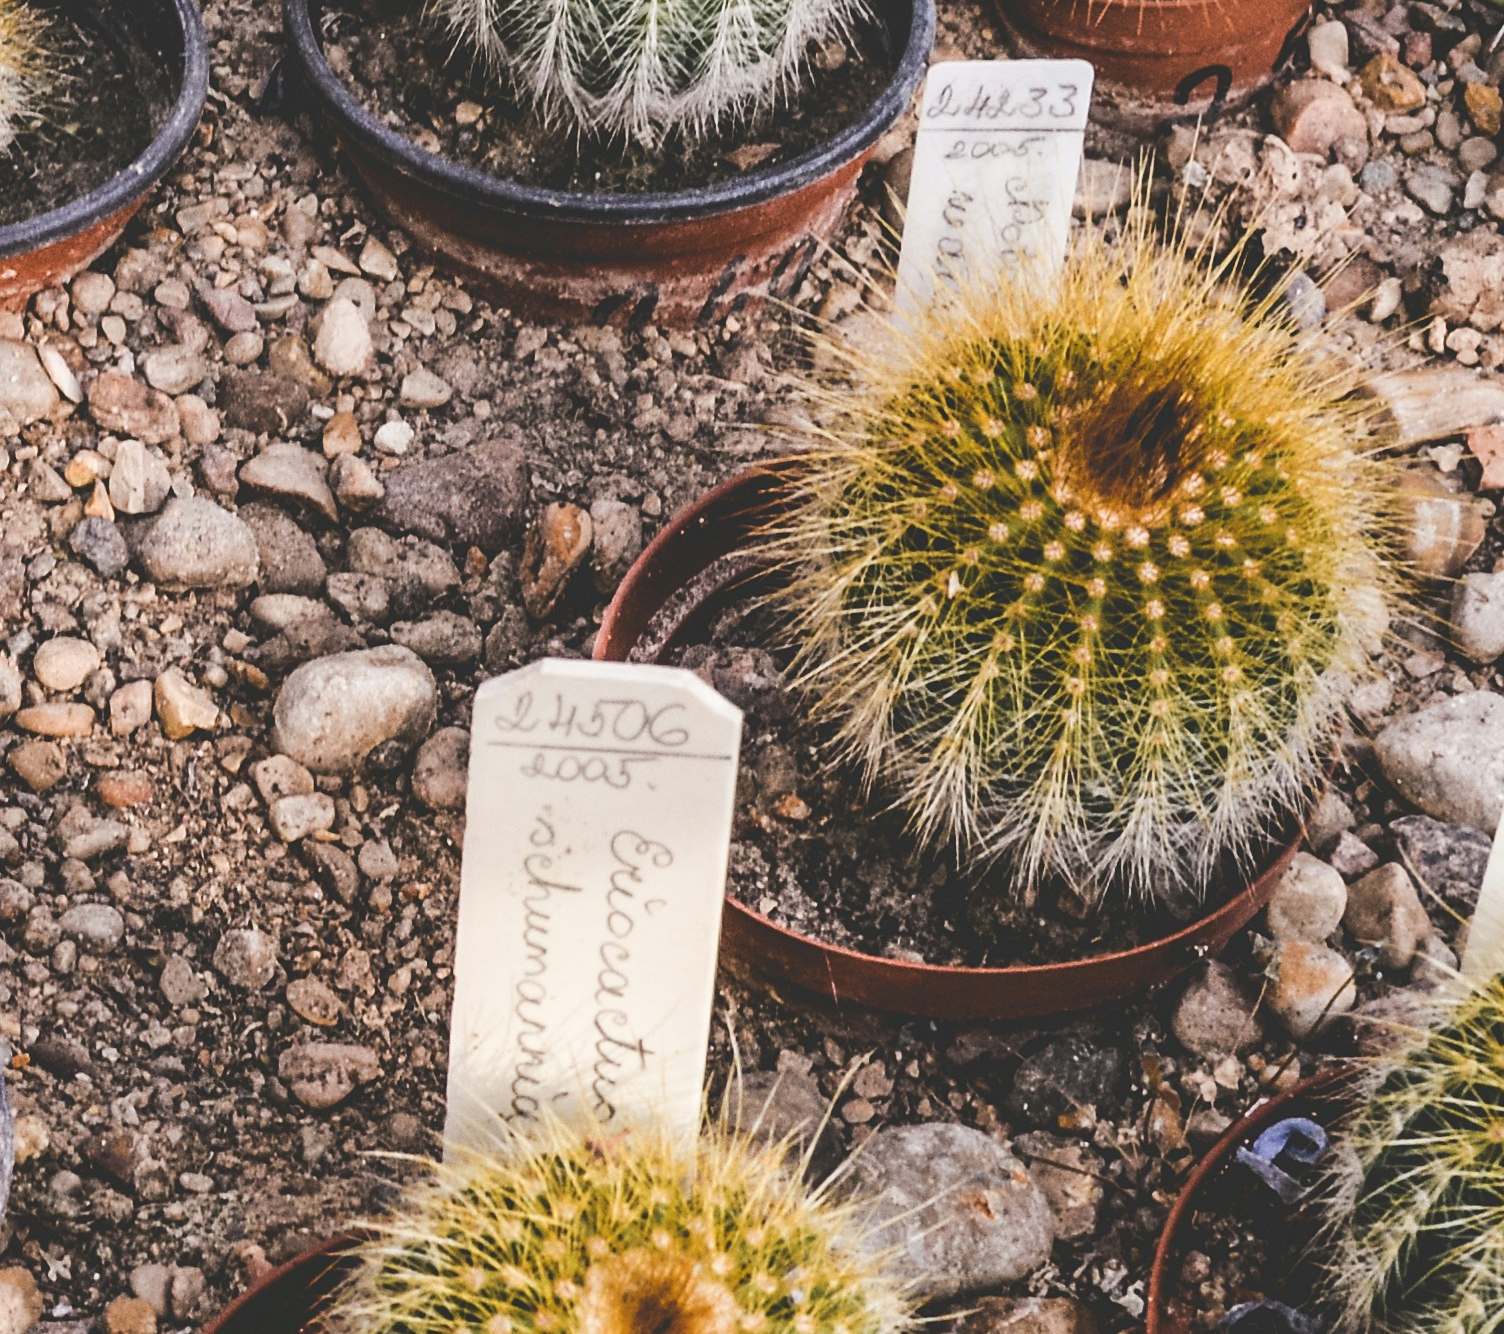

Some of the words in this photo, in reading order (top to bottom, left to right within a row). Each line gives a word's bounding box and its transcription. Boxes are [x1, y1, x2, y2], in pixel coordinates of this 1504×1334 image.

[925, 73, 1078, 121] 24233
[493, 694, 693, 747] 24506
[591, 828, 677, 1129] Eriocactus
